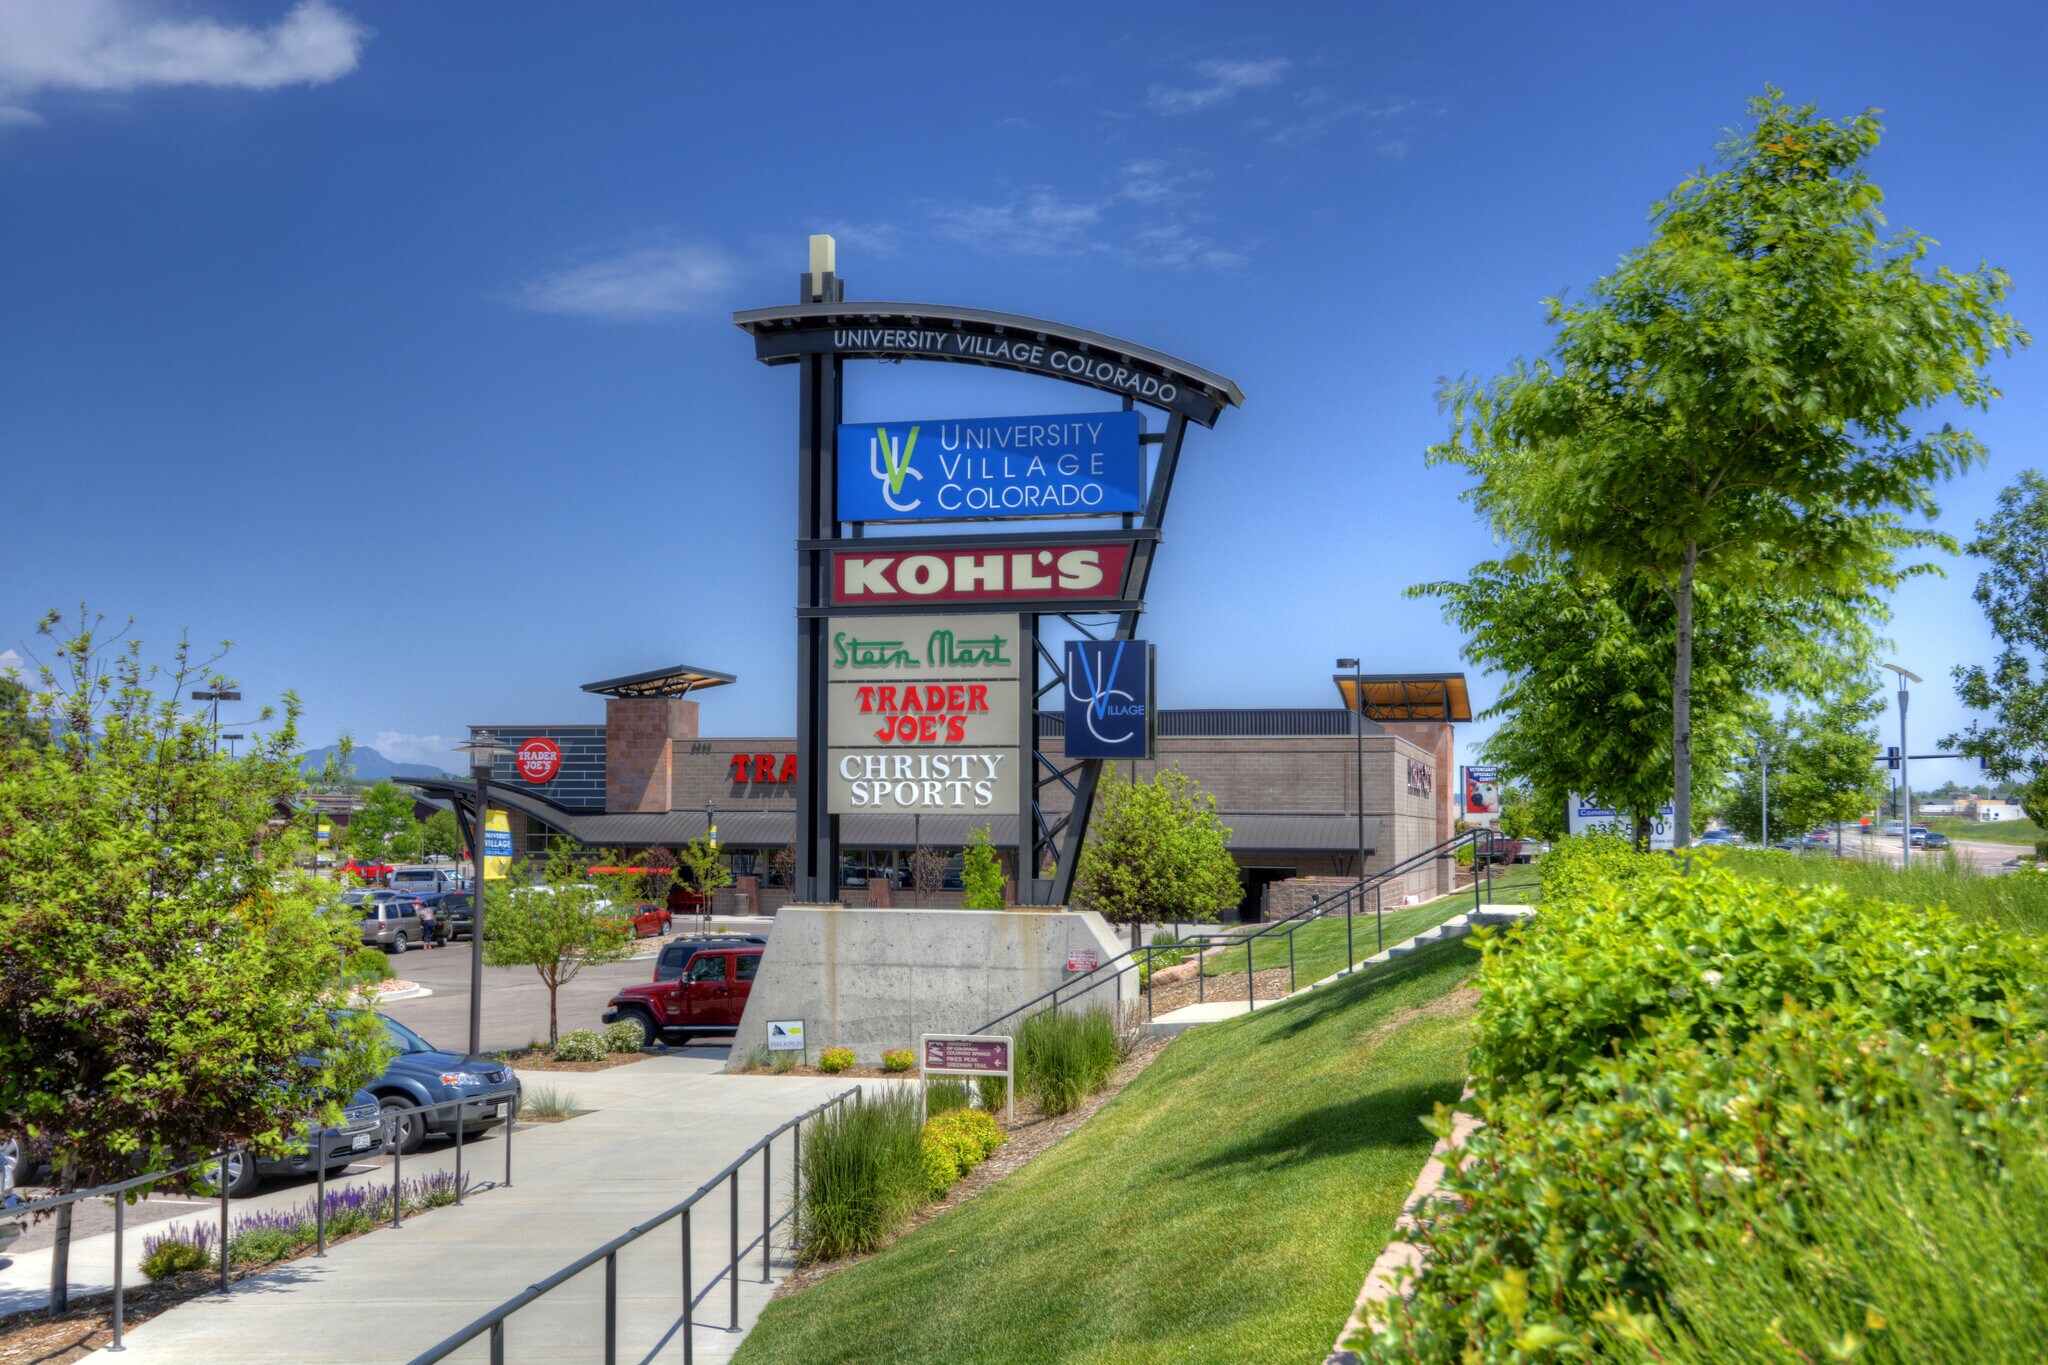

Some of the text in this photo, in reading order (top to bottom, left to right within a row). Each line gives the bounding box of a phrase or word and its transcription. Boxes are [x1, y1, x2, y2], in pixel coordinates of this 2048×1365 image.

[834, 329, 1177, 402] UNIVERSITY VILLAGE COLORADO
[941, 422, 1103, 450] UNIVERSITY
[939, 453, 1104, 480] VILLAGE
[937, 483, 1103, 510] COLORADO
[843, 550, 1103, 595] KOHL'S
[834, 629, 1011, 666] Stein Mart
[856, 685, 990, 712] TRADER
[876, 713, 968, 742] JOE'S
[518, 751, 557, 760] TRADER
[523, 760, 552, 770] JOE'S
[730, 754, 798, 783] TRA
[839, 754, 1005, 780] CHRISTY
[851, 781, 993, 806] SPORTS
[485, 840, 511, 848] VILLAGE
